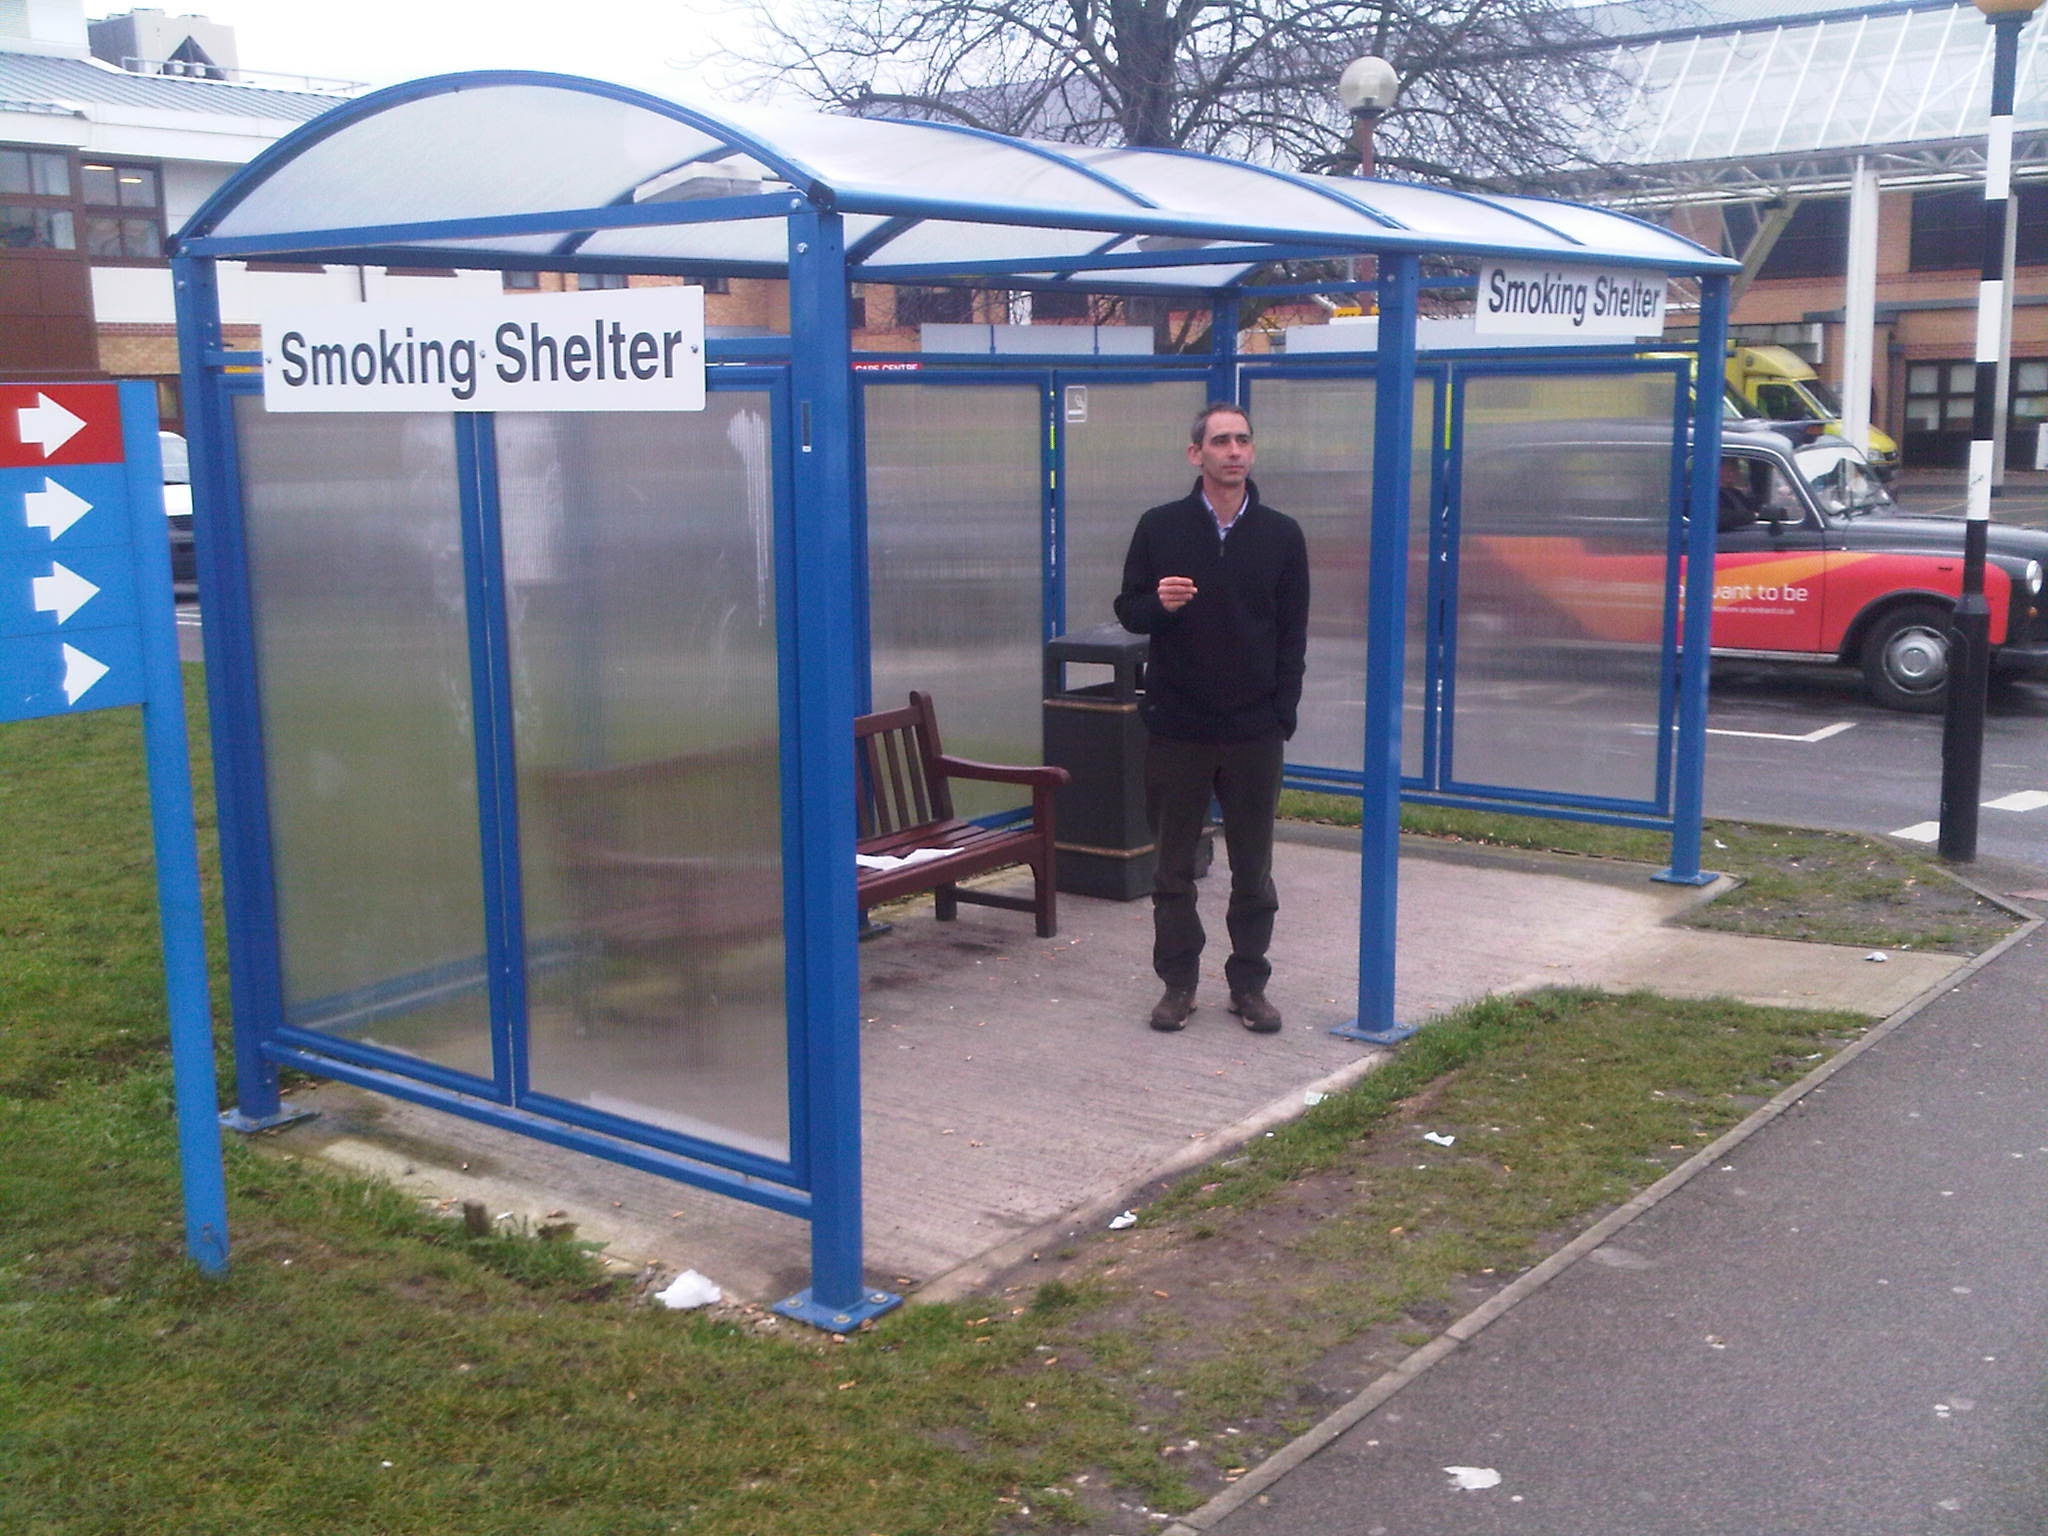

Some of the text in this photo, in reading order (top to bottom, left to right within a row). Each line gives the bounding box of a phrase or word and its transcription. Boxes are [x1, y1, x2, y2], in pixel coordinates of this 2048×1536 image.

[1489, 268, 1661, 327] Smoking Shelter
[281, 319, 683, 400] Smoking Shelter
[1758, 584, 1778, 601] to
[1783, 583, 1808, 601] be
